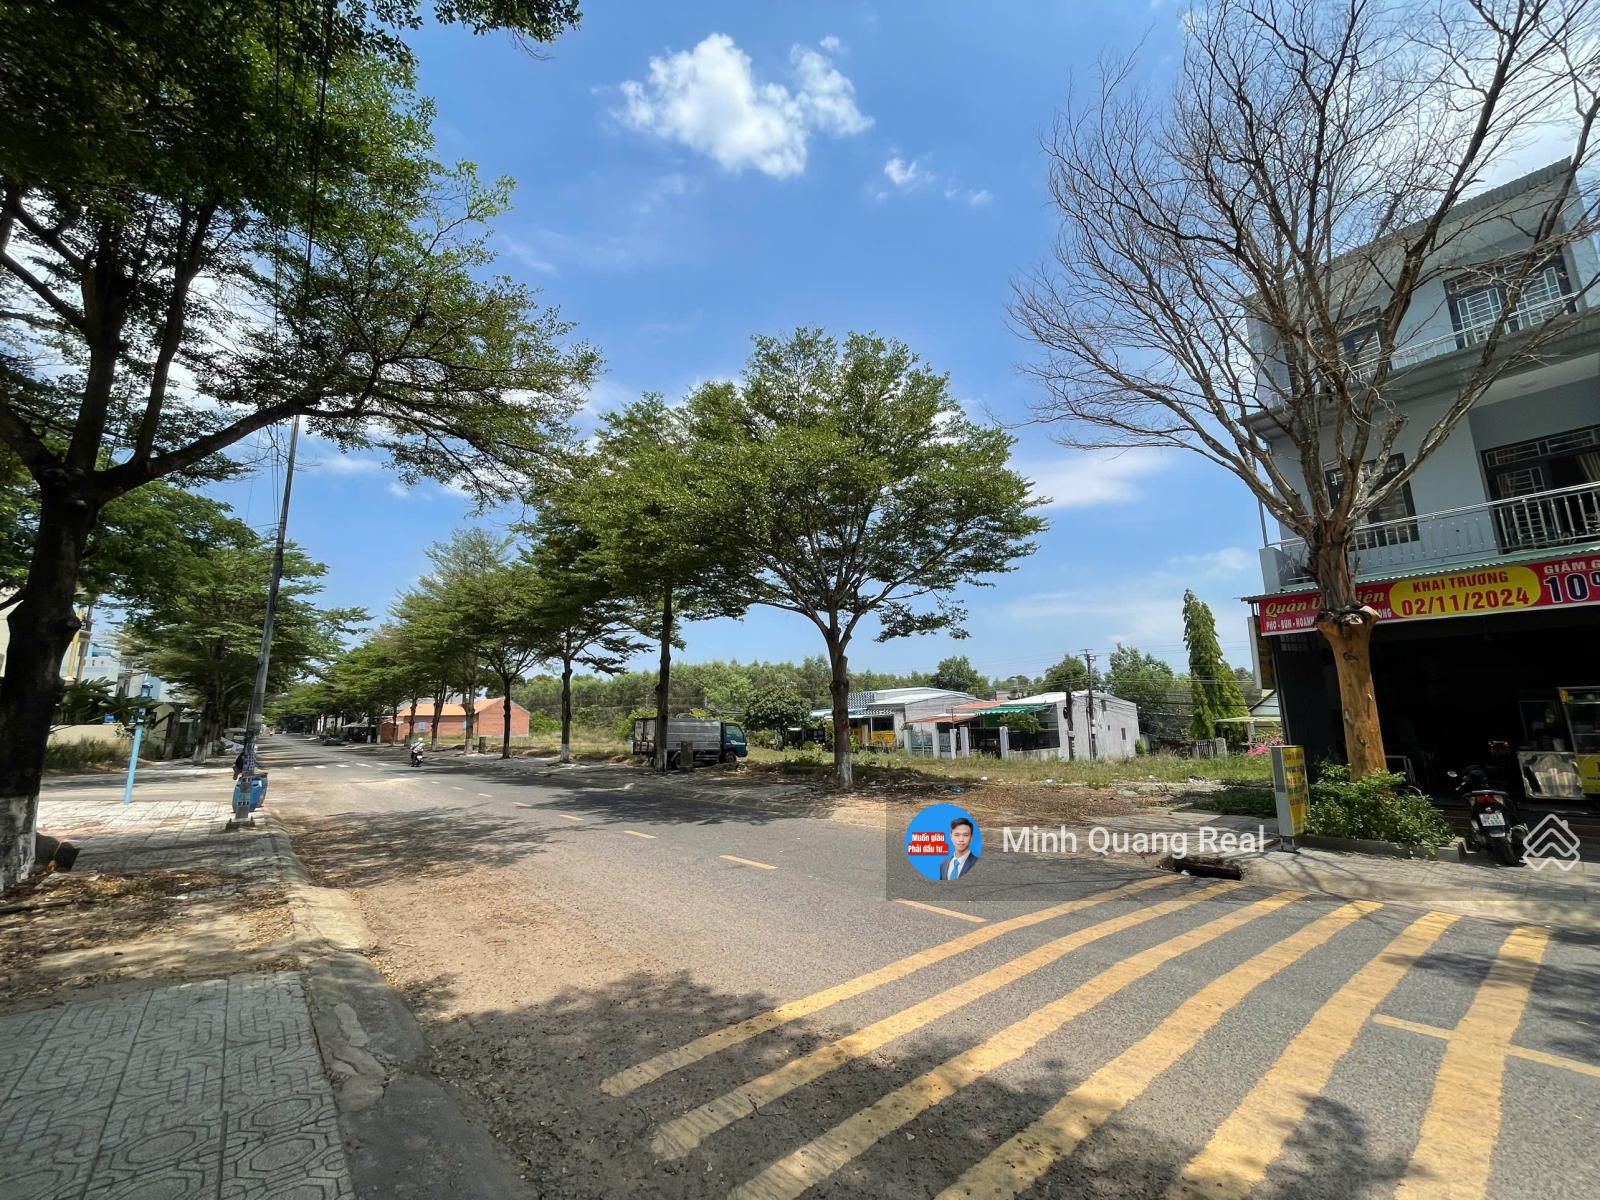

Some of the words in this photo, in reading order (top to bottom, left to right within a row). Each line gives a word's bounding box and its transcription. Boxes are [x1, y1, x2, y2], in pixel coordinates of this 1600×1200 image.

[1543, 560, 1586, 574] GIẢM
[1412, 579, 1446, 593] KHAI
[1449, 571, 1509, 589] TRƯƠNG
[1265, 600, 1307, 617] Quán
[1401, 587, 1530, 616] 02/11/2024
